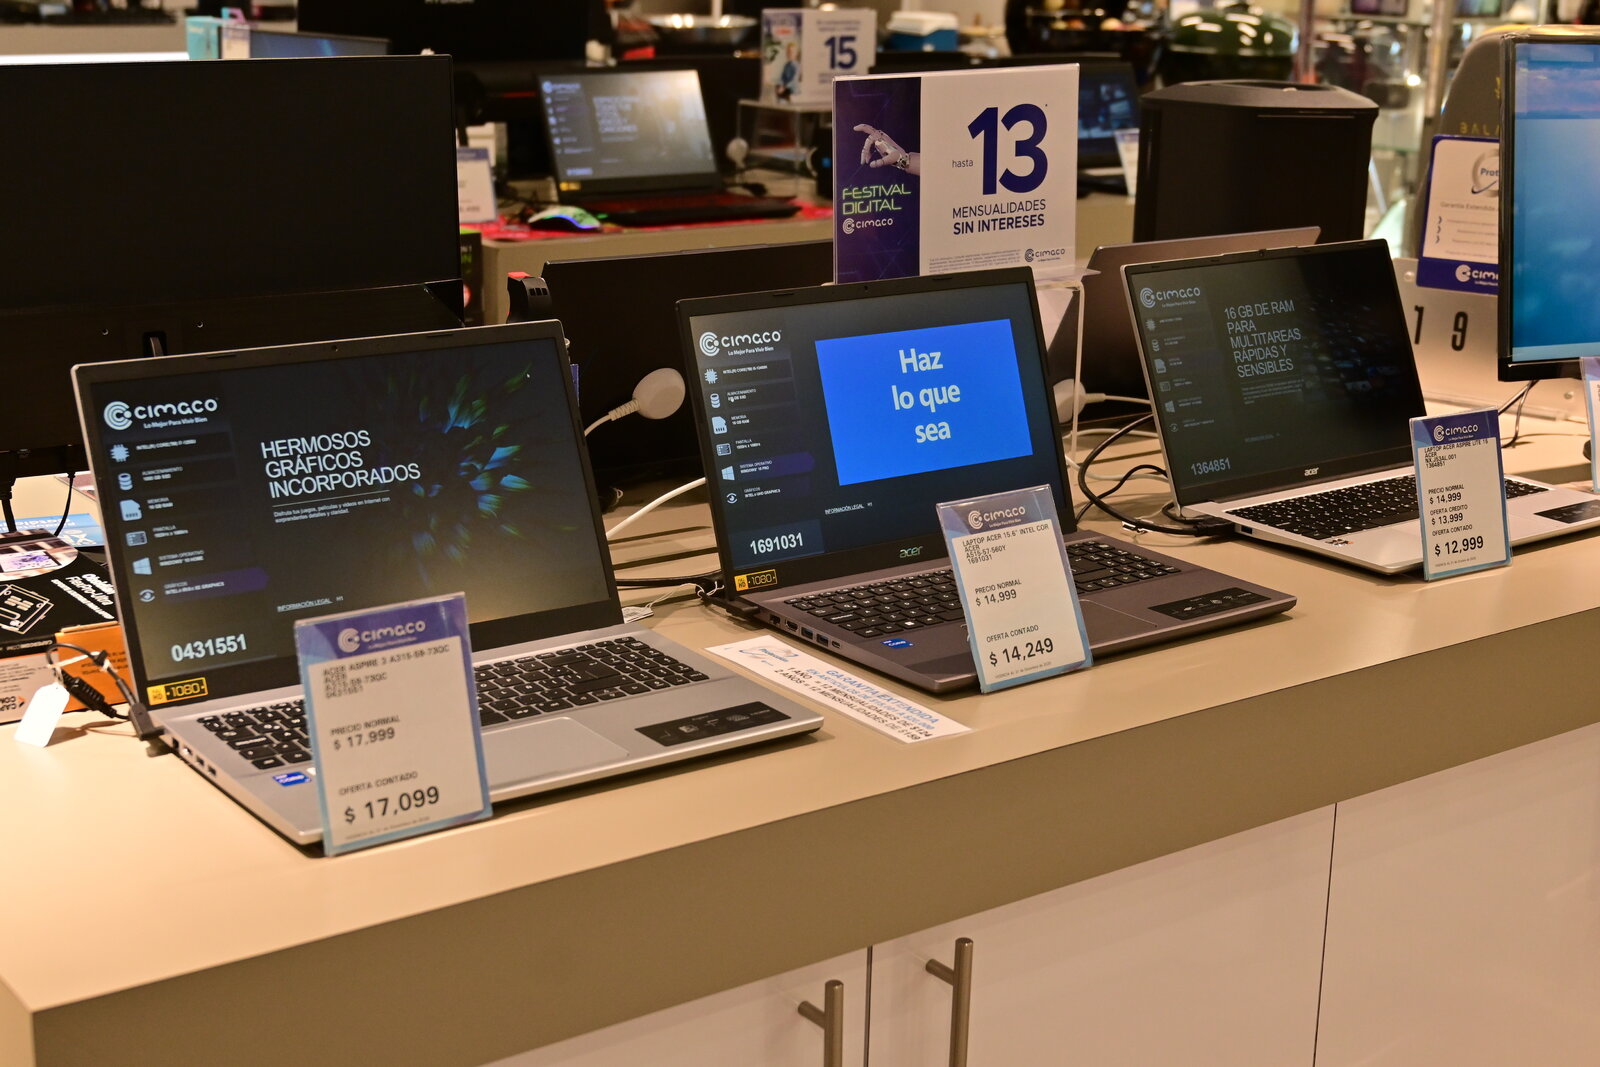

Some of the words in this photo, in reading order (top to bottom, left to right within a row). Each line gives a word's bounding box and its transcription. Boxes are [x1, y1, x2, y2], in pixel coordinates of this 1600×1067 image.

[824, 36, 857, 70] 15
[967, 103, 1048, 196] 13
[952, 159, 974, 168] hasta
[842, 184, 912, 201] FESTIVAL
[842, 199, 902, 216] DIGITAL
[952, 199, 1046, 218] MENSUALIDADES
[953, 219, 976, 236] SIN
[978, 214, 1045, 232] INTERESES
[1224, 307, 1236, 320] 16
[1238, 304, 1254, 318] GB
[1255, 302, 1270, 316] DE
[1272, 300, 1295, 314] RAM
[1226, 320, 1256, 334] PARA
[1451, 312, 1468, 352] 9
[721, 331, 780, 348] cimaco
[1230, 328, 1302, 349] MULTITAREAS
[899, 348, 944, 374] Haz
[1234, 346, 1280, 364] RÁPIDAS
[1279, 344, 1287, 356] Y
[1237, 358, 1294, 378] SENSIBLES
[892, 385, 914, 410] lo
[919, 384, 960, 412] que
[134, 399, 218, 419] cimaco
[915, 421, 952, 444] sea
[1445, 424, 1478, 436] cimaco
[260, 430, 370, 458] HERMOSOS
[1424, 446, 1442, 454] LAPTOP
[265, 451, 364, 478] GRÁFICOS
[1191, 458, 1231, 476] 1364851
[1304, 467, 1319, 476] acer
[269, 463, 421, 498] INCORPORADOS
[984, 506, 1026, 522] cimaco
[1449, 504, 1468, 512] CREDITO
[962, 536, 984, 548] LAPTOP
[986, 534, 1002, 542] ACER
[1020, 526, 1036, 534] INTEL
[1037, 524, 1049, 532] COR
[1432, 528, 1450, 536] OFERTA
[1450, 524, 1472, 534] CONTADO
[750, 532, 804, 554] 1691031
[900, 546, 923, 558] acer
[1434, 544, 1440, 556] $
[1445, 536, 1484, 554] 12,999
[968, 554, 992, 564] 1691031
[751, 574, 772, 586] 1080
[975, 584, 996, 594] PRECIO
[997, 578, 1022, 590] NORMAL
[976, 598, 981, 606] $
[984, 589, 1017, 604] 14,999
[361, 620, 426, 642] cimaco
[986, 632, 1009, 642] OFERTA
[1010, 625, 1039, 637] CONTADO
[170, 634, 247, 662] 0431551
[989, 652, 998, 667] $
[1002, 638, 1054, 663] 14,249
[170, 682, 200, 697] 1080
[820, 690, 888, 724] MENSUALIDADES
[832, 688, 900, 721] MENSUALIDADES
[878, 694, 939, 724] EXTENDIDA
[330, 723, 362, 736] PRECIO
[364, 716, 400, 728] NORMAL
[334, 740, 341, 750] $
[338, 783, 372, 796] OFERTA
[375, 771, 418, 788] CONTADO
[344, 807, 356, 825] $
[365, 786, 440, 819] 17,099
